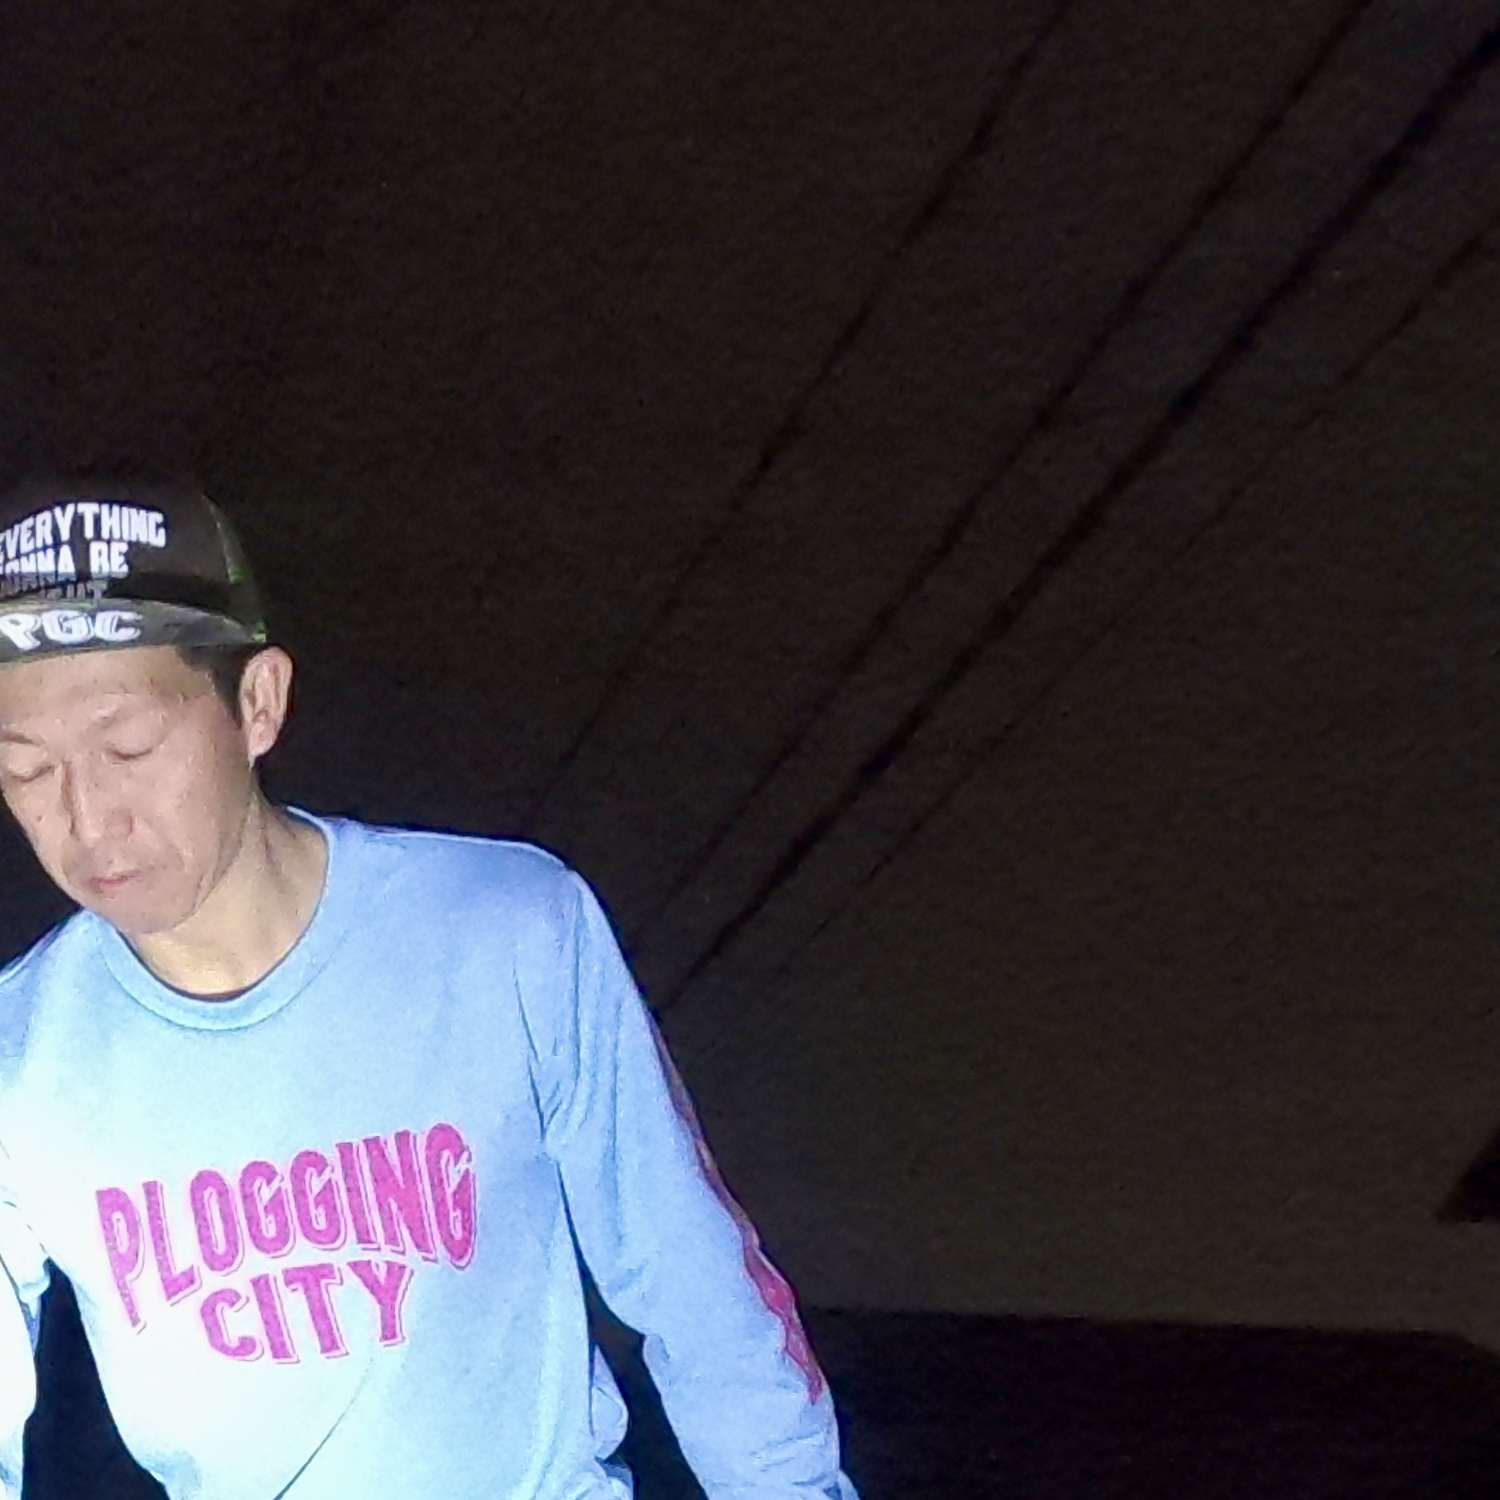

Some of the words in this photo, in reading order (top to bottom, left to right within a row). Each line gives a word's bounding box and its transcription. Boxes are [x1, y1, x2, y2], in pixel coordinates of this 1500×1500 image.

[89, 540, 130, 578] BE
[95, 1121, 478, 1335] PLOGGING
[199, 1258, 415, 1364] CITY
